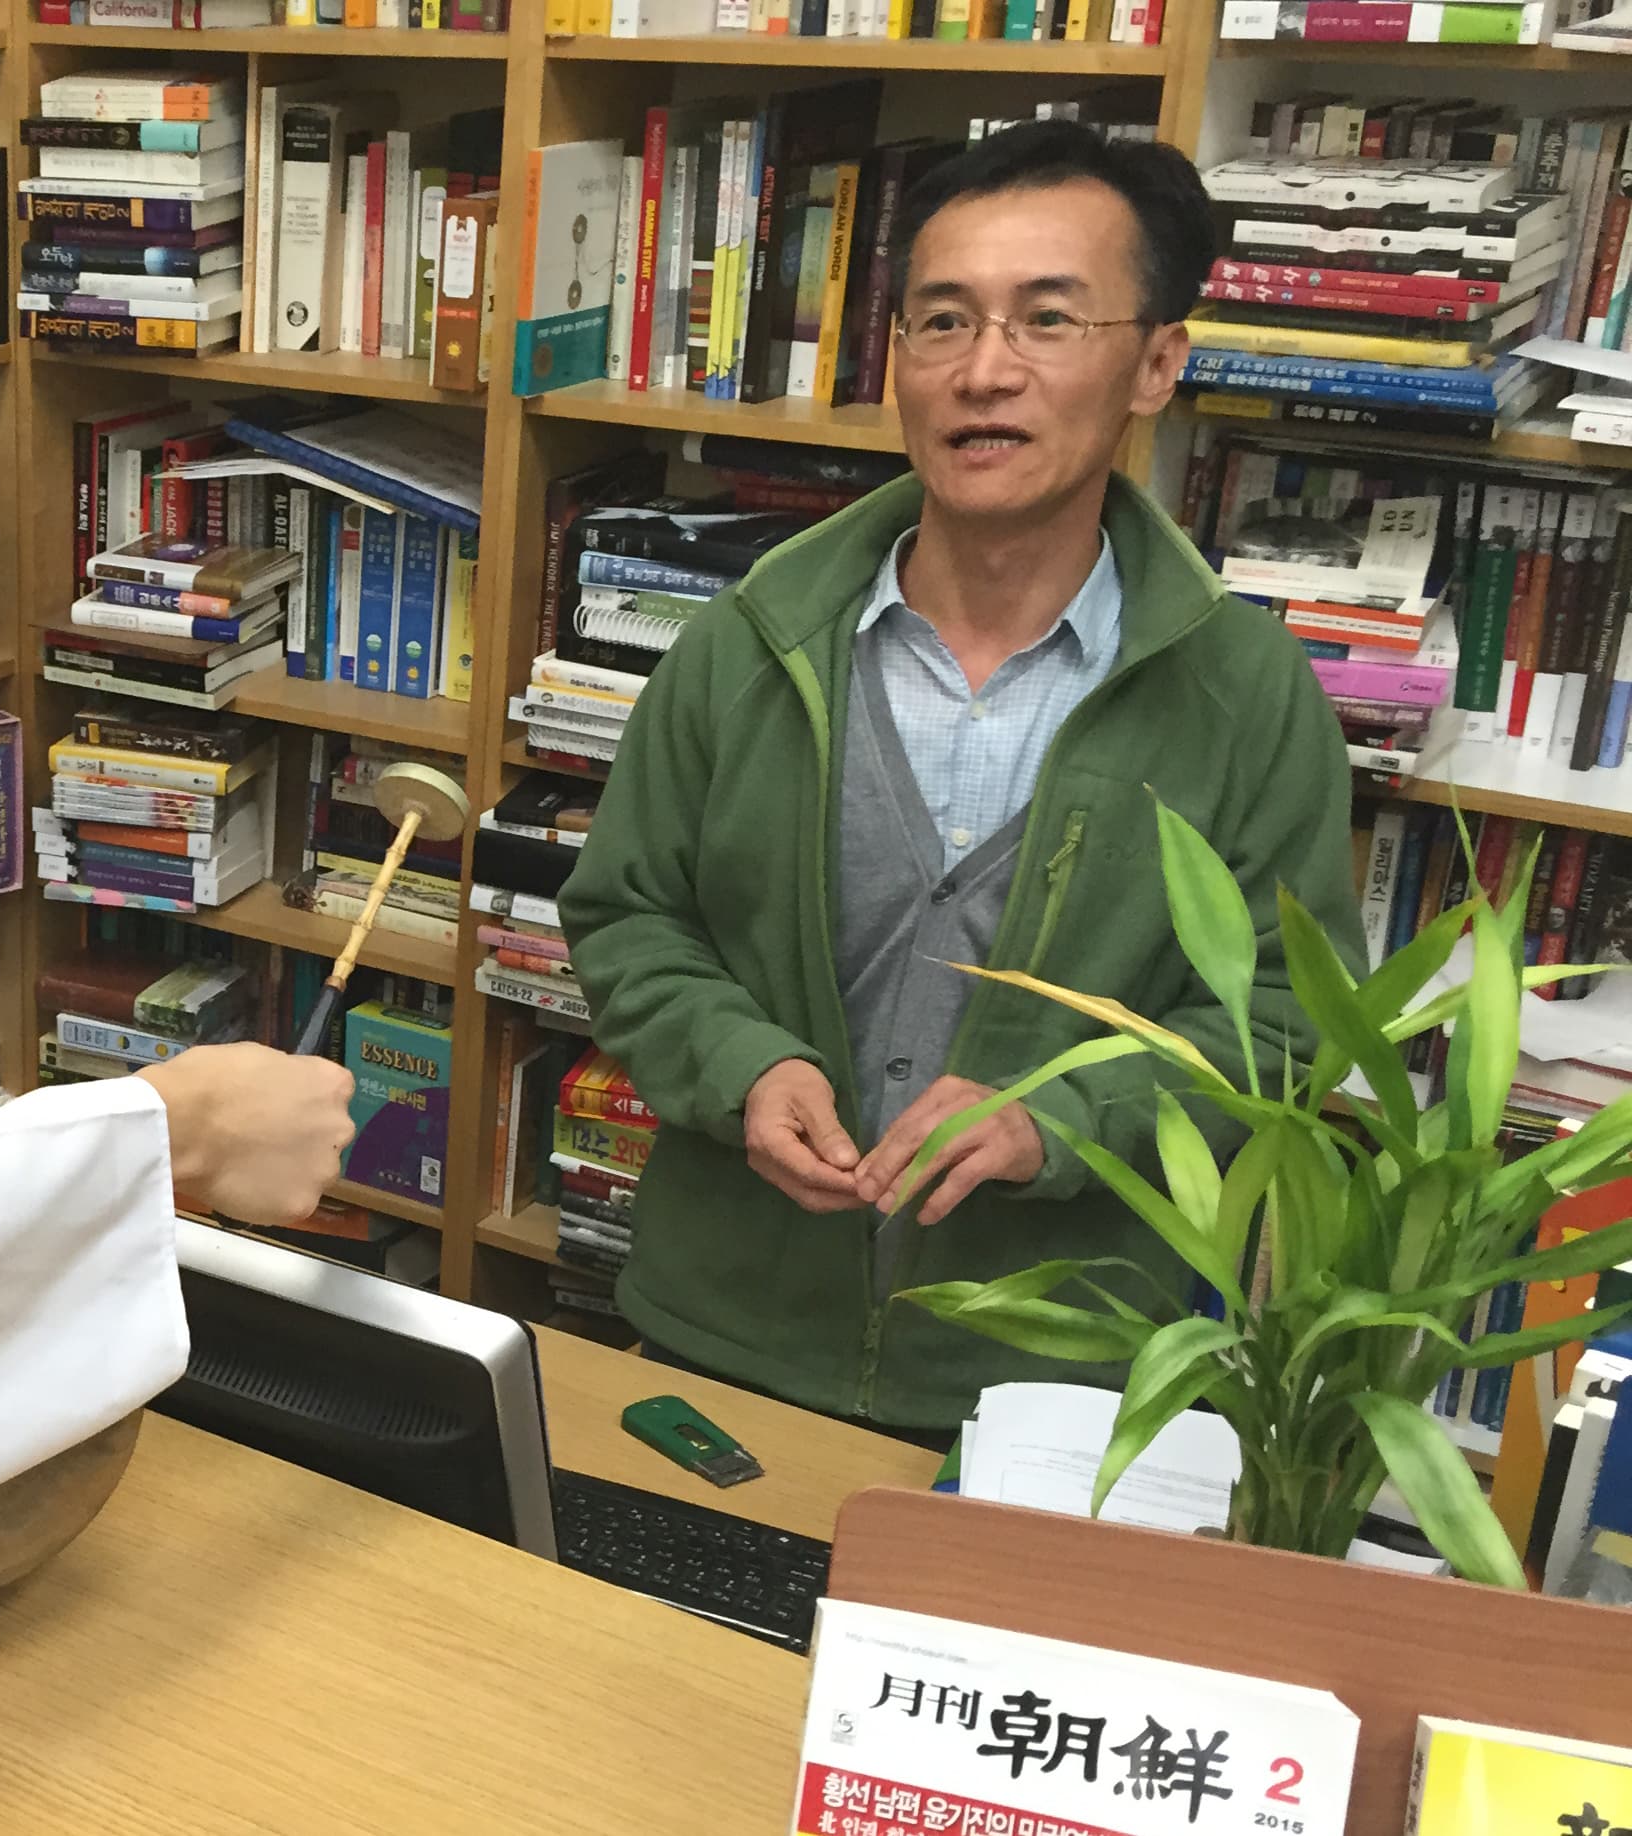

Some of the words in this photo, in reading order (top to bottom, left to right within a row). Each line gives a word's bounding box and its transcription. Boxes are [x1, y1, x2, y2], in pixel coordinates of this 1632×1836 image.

[93, 1, 158, 18] California
[760, 165, 776, 210] ACTUAL
[834, 178, 850, 232] KOREAN
[642, 199, 656, 247] GRAMMAR
[757, 214, 771, 242] TEST
[639, 249, 652, 280] START
[829, 234, 846, 281] WORDS
[165, 502, 177, 537] JACK
[549, 522, 560, 543] JIMI
[546, 548, 558, 592] HENDRIX
[544, 598, 556, 617] THE
[1604, 591, 1621, 626] Korean
[1593, 628, 1613, 673] Paintings
[1578, 851, 1604, 914] MOZART
[490, 980, 533, 1002] CATCH-22
[559, 999, 590, 1016] JOSEP
[360, 1040, 438, 1081] ESSENCE
[358, 1077, 388, 1098] 엣센스
[870, 1671, 982, 1732] 月刊
[976, 1689, 1234, 1825] 朝鮮
[1265, 1756, 1305, 1806] 2
[821, 1771, 870, 1813] 황선
[873, 1785, 921, 1826] 남편
[922, 1795, 1016, 1836] 윤기진의
[818, 1811, 838, 1835] 北
[1254, 1810, 1305, 1836] 2015
